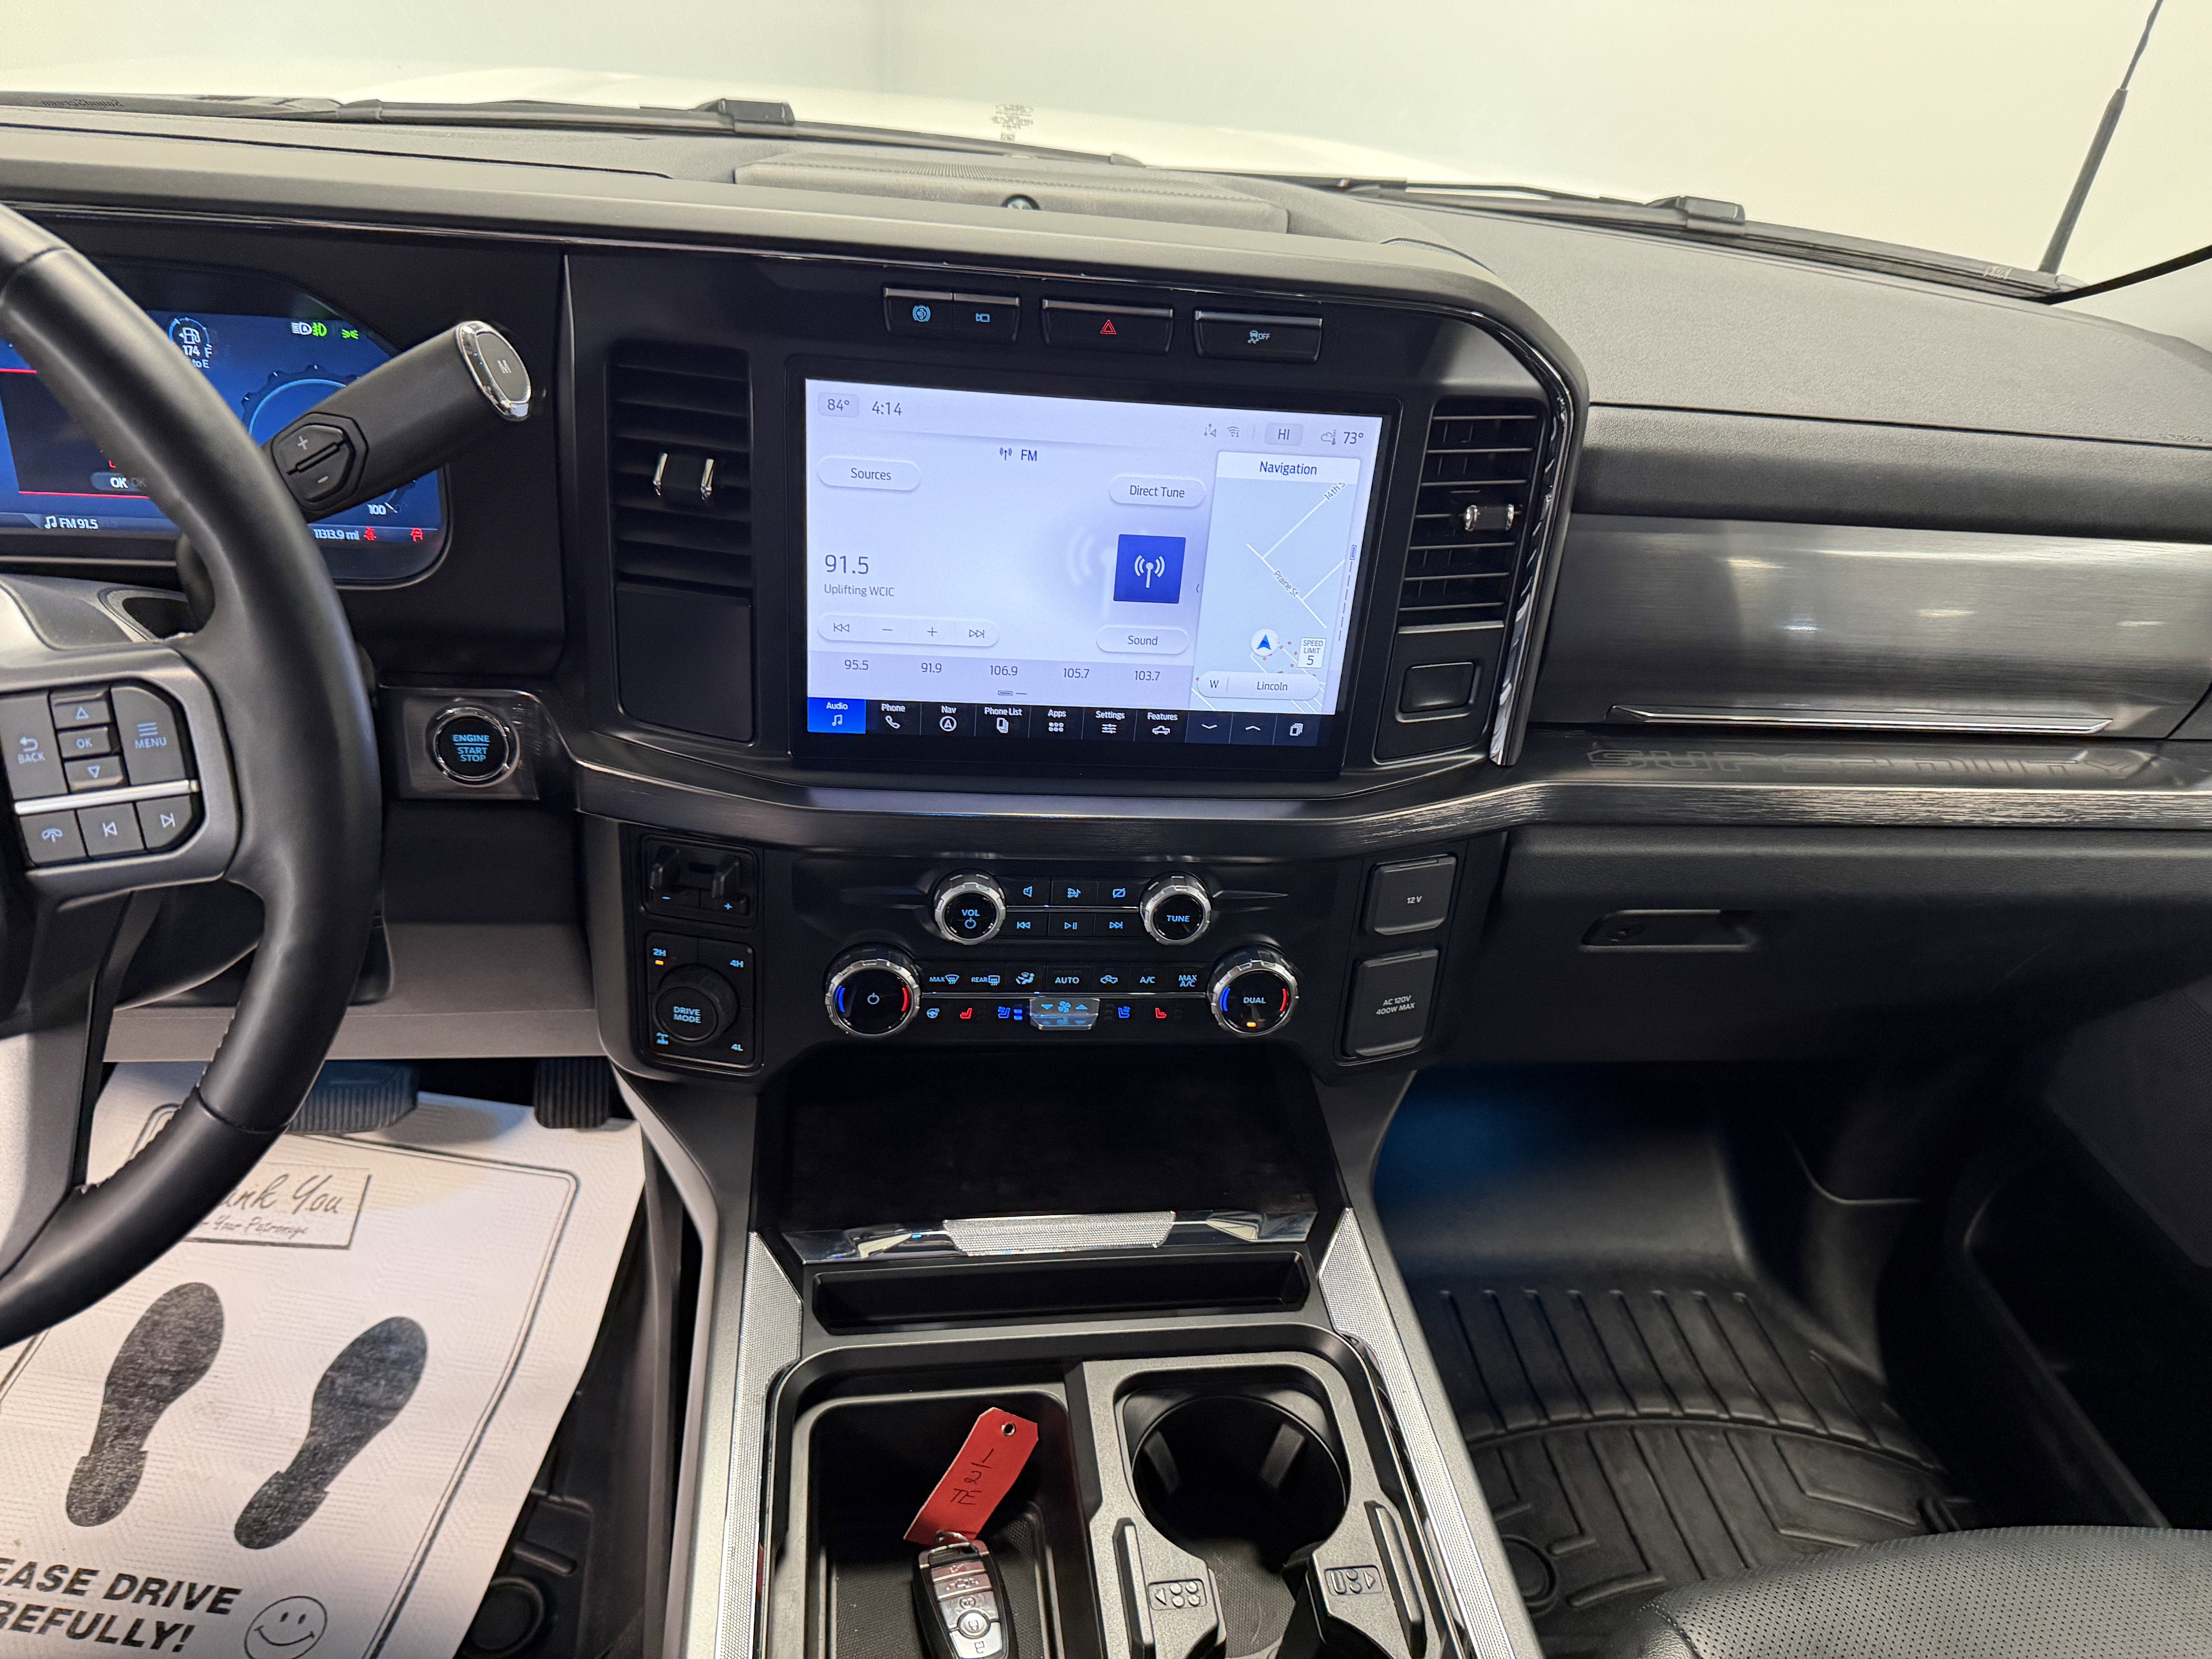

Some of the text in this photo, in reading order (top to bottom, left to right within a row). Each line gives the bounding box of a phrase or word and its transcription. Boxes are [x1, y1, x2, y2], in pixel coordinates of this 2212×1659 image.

[182, 345, 201, 356] 174
[204, 347, 212, 358] F
[497, 359, 511, 374] M
[827, 398, 902, 416] 84° 4:14
[1278, 429, 1290, 440] HI
[1343, 431, 1364, 445] 73°
[1020, 450, 1038, 461] FM
[850, 467, 891, 481] Sources
[1259, 461, 1317, 476] Navigation
[110, 477, 128, 488] OK
[1130, 485, 1185, 498] Direct Tune
[1324, 486, 1340, 500] 14th
[367, 504, 386, 515] 100
[58, 518, 98, 529] FM 91.5
[345, 530, 360, 540] mi
[824, 555, 869, 574] 91.5
[824, 583, 895, 597] Uplifting WCIC
[1128, 635, 1158, 646] Sound
[844, 659, 869, 671] 95.5
[1306, 655, 1314, 665] 5
[921, 663, 942, 673] 91.9
[989, 665, 1018, 676] 106.9
[1063, 668, 1089, 679] 105.7
[1134, 670, 1160, 682] 103.7
[1209, 680, 1219, 689] W
[1257, 681, 1288, 691] Lincoln
[826, 701, 848, 711] Audio
[881, 703, 905, 713] Phone
[941, 706, 957, 714] Nav
[984, 706, 1023, 716] Phone List
[1048, 709, 1066, 718] Apps
[1096, 710, 1125, 720] Settings
[1147, 712, 1178, 721] Features
[77, 738, 93, 749] OK
[134, 737, 167, 749] MENU
[452, 734, 490, 743] ENGINE
[457, 747, 488, 755] START
[17, 752, 45, 764] BACK
[1587, 749, 1892, 774] SUPER
[1407, 896, 1415, 904] 12
[962, 909, 980, 917] VOL
[1166, 914, 1190, 922] TUNE
[653, 948, 666, 957] 2H
[730, 960, 744, 968] 4H
[1055, 976, 1080, 984] AUTO
[1140, 976, 1156, 984] A/C
[1243, 996, 1266, 1005] DUAL
[1395, 995, 1412, 1004] 120V
[673, 1006, 701, 1016] DRIVE
[1376, 1002, 1416, 1015] 400W MAX
[673, 1013, 702, 1024] MODE
[731, 1044, 744, 1052] 4L
[292, 1174, 343, 1215] You
[0, 1557, 243, 1615] EASE DRIVE
[0, 1599, 196, 1653] REFULLY!
